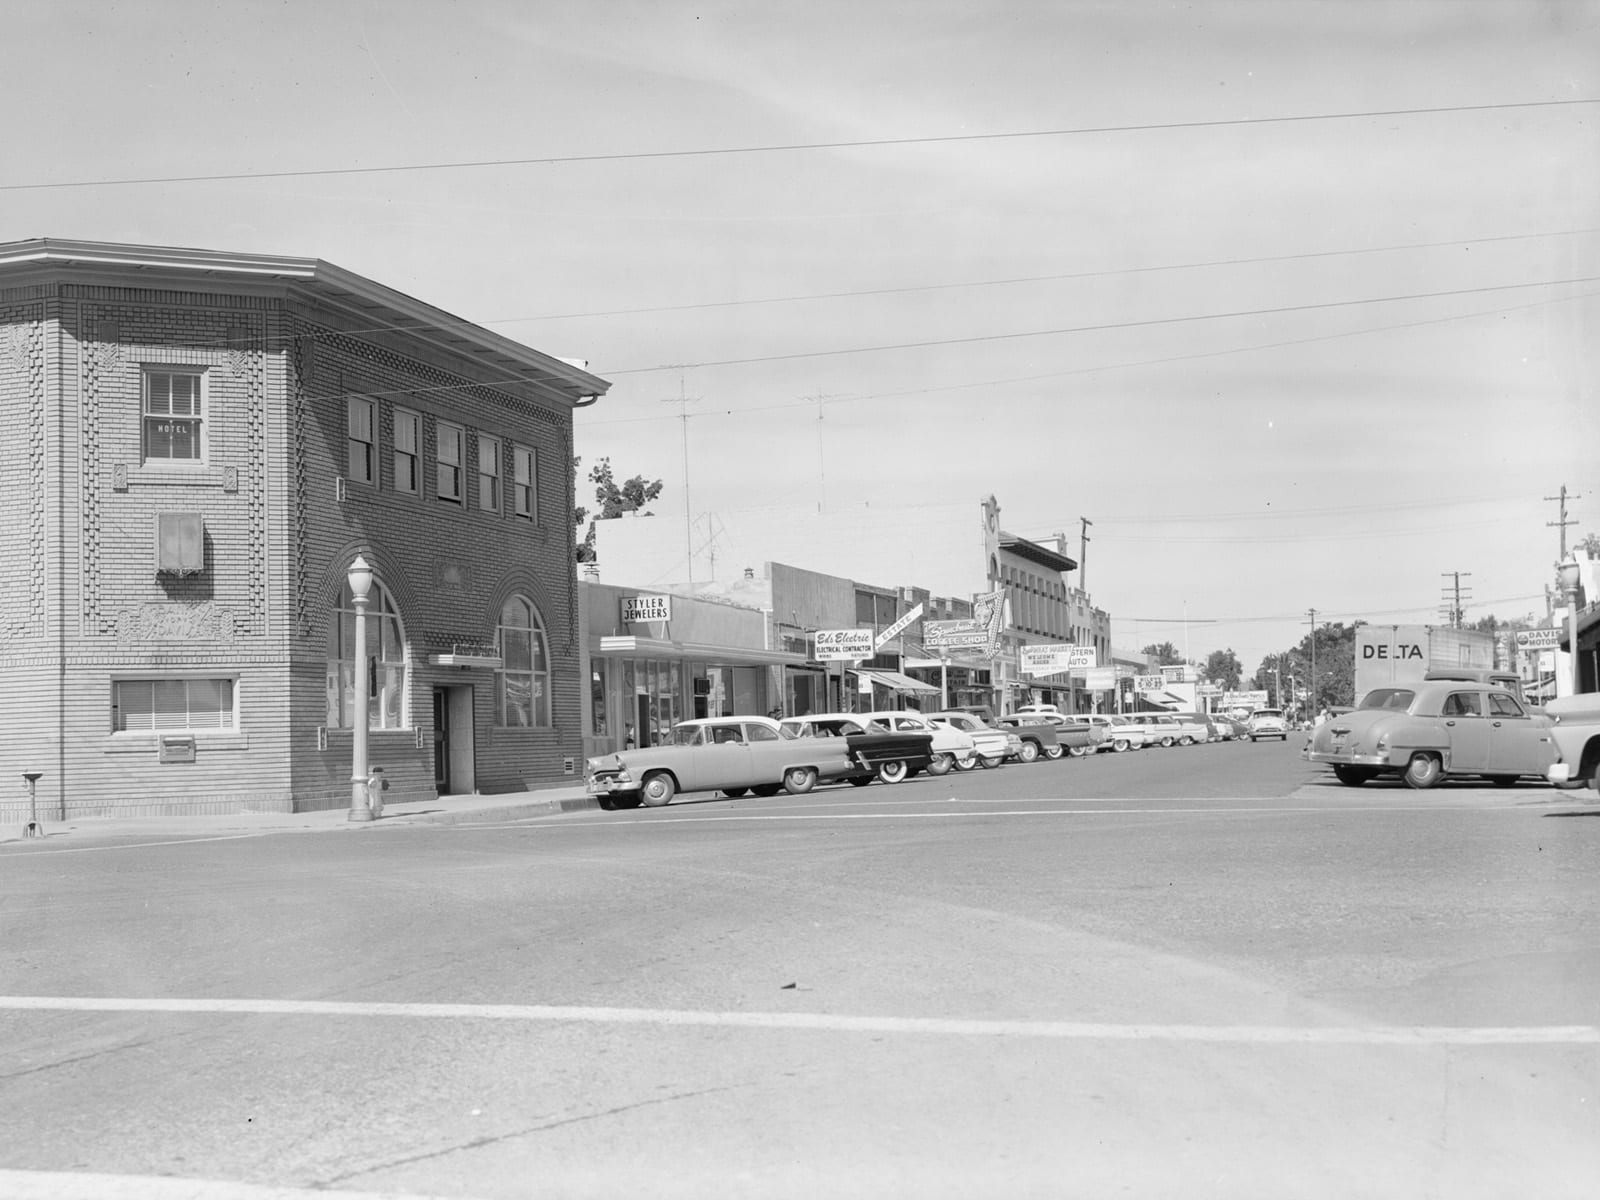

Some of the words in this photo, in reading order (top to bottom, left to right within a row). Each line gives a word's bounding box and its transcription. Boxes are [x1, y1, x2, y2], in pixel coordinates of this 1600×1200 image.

[158, 424, 187, 434] HOTEL
[627, 598, 664, 609] STYLER
[624, 608, 667, 620] JEWELERS
[881, 613, 912, 641] ESTATE
[835, 632, 869, 643] Electric
[1528, 630, 1561, 638] DAVIS
[926, 637, 959, 646] COFFEE
[962, 635, 987, 644] SHOP
[1528, 638, 1560, 646] MOTOR
[1071, 648, 1094, 657] STERN
